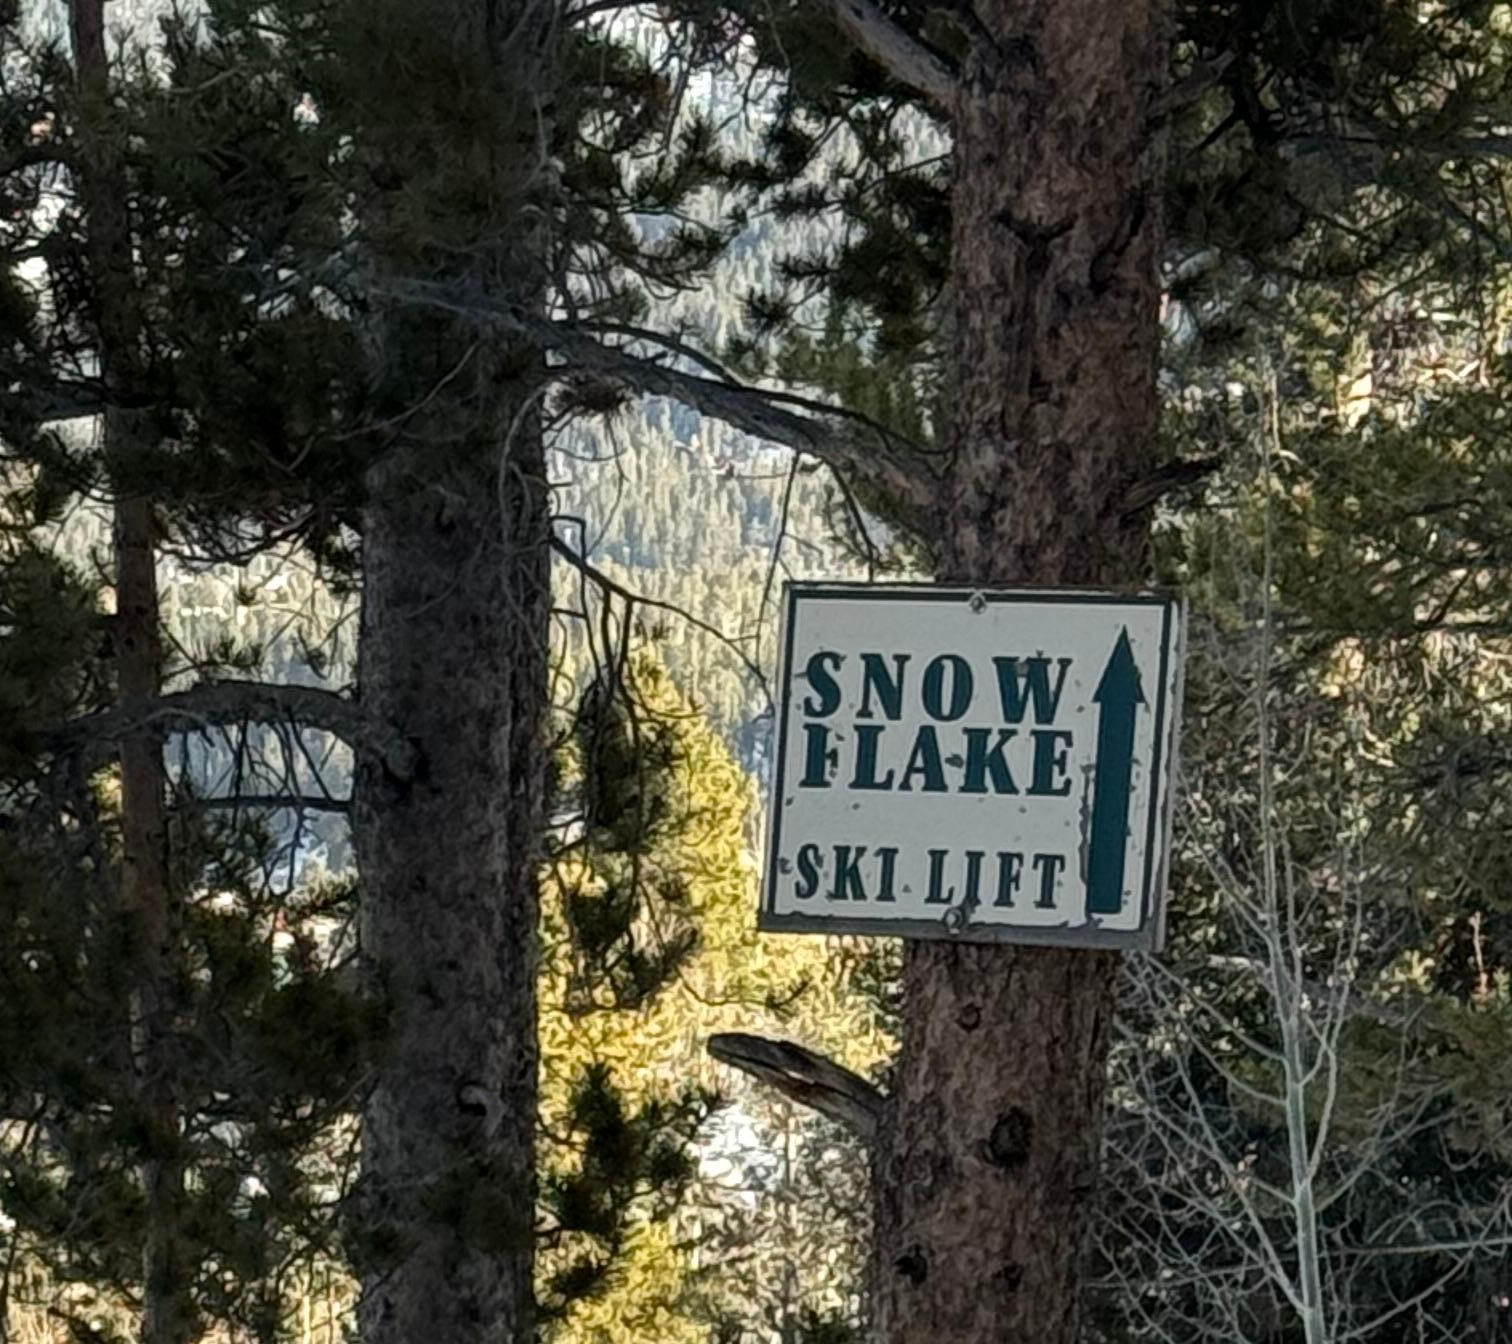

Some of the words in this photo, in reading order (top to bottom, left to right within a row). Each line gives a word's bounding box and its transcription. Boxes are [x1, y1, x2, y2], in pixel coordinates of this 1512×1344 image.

[803, 650, 1074, 725] SNOW
[799, 722, 1074, 797] FLAKE
[795, 843, 899, 902] SKI
[924, 849, 1066, 909] LIFT
